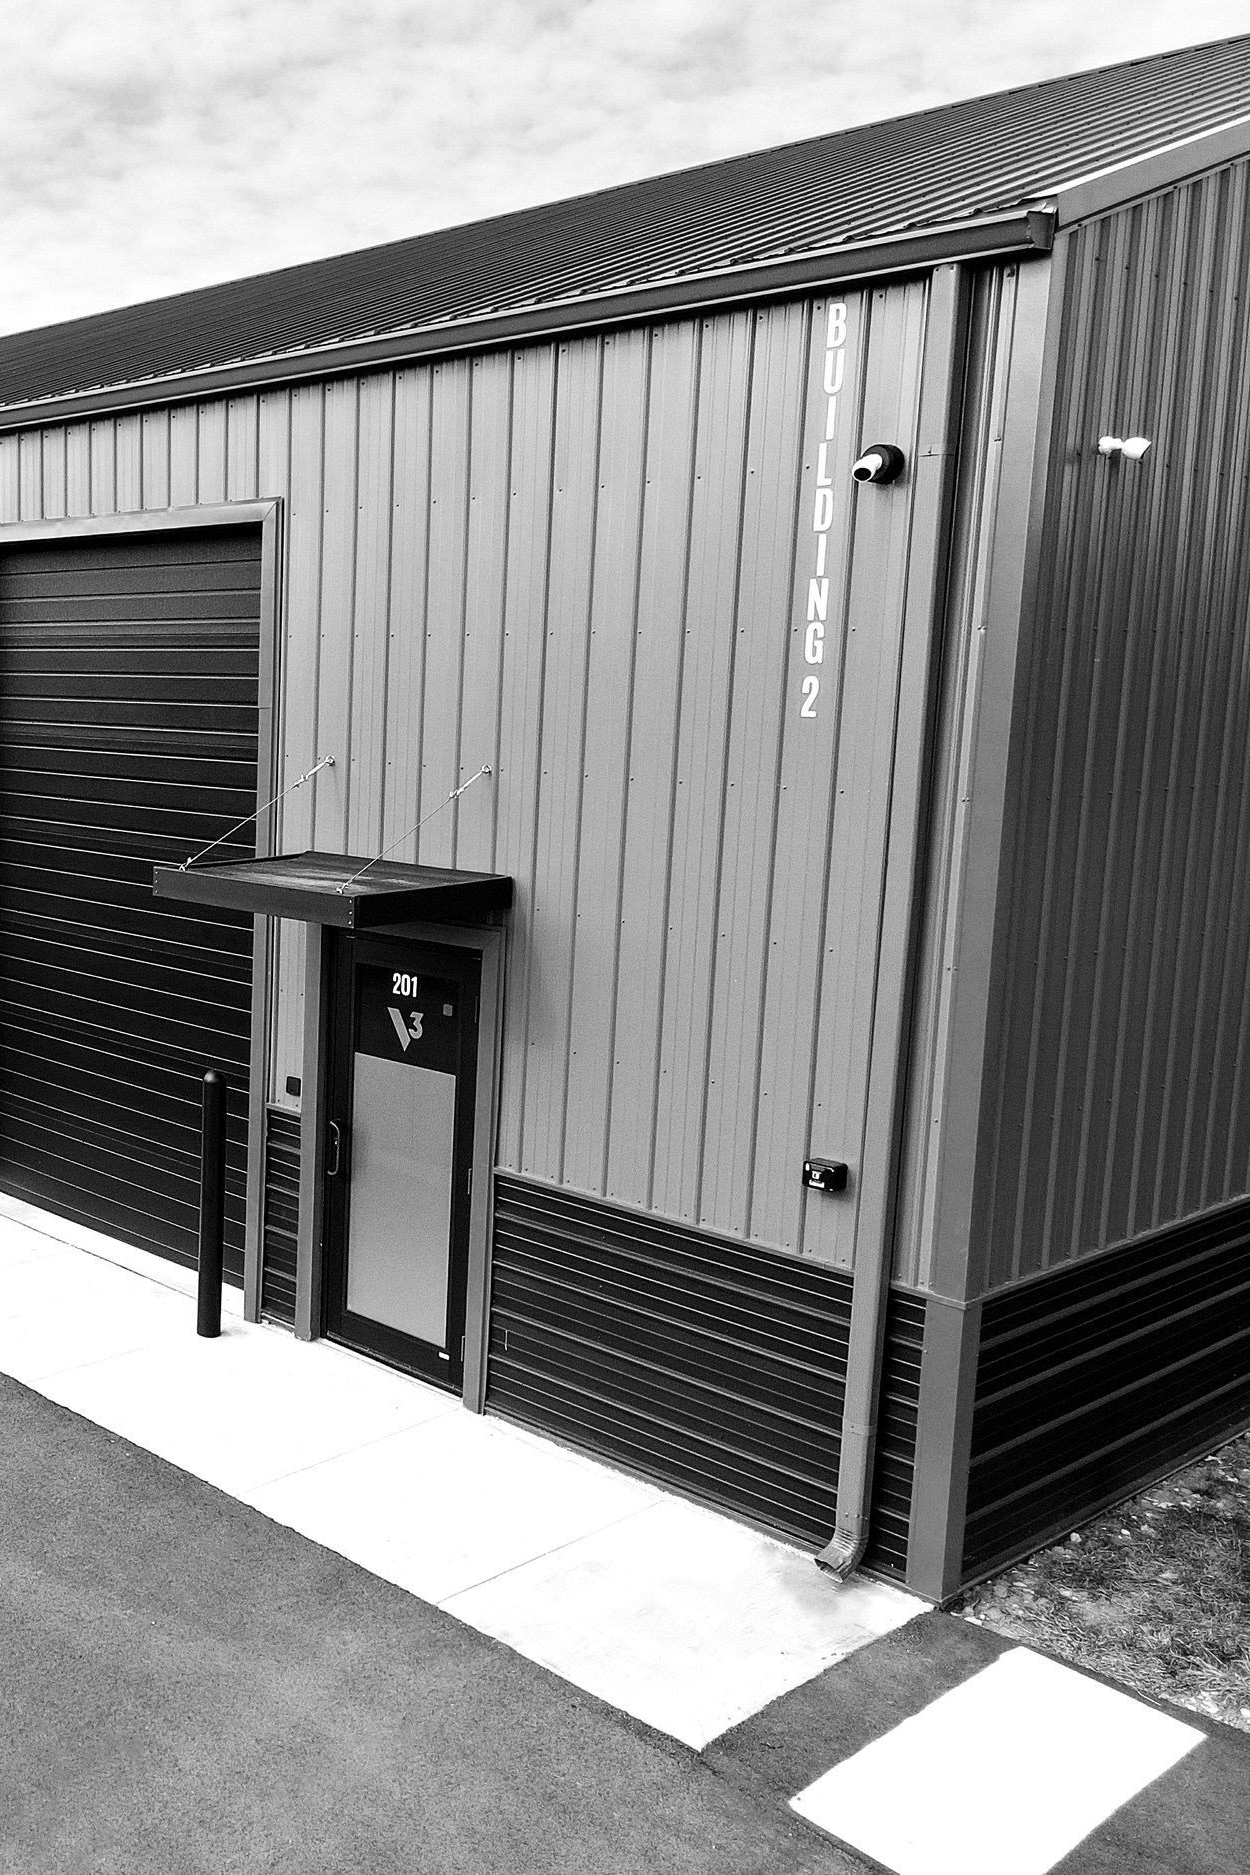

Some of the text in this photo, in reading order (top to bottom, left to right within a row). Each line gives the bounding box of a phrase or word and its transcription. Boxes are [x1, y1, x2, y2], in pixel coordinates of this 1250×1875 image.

[800, 302, 847, 718] BUILDING 2
[392, 972, 418, 998] 201
